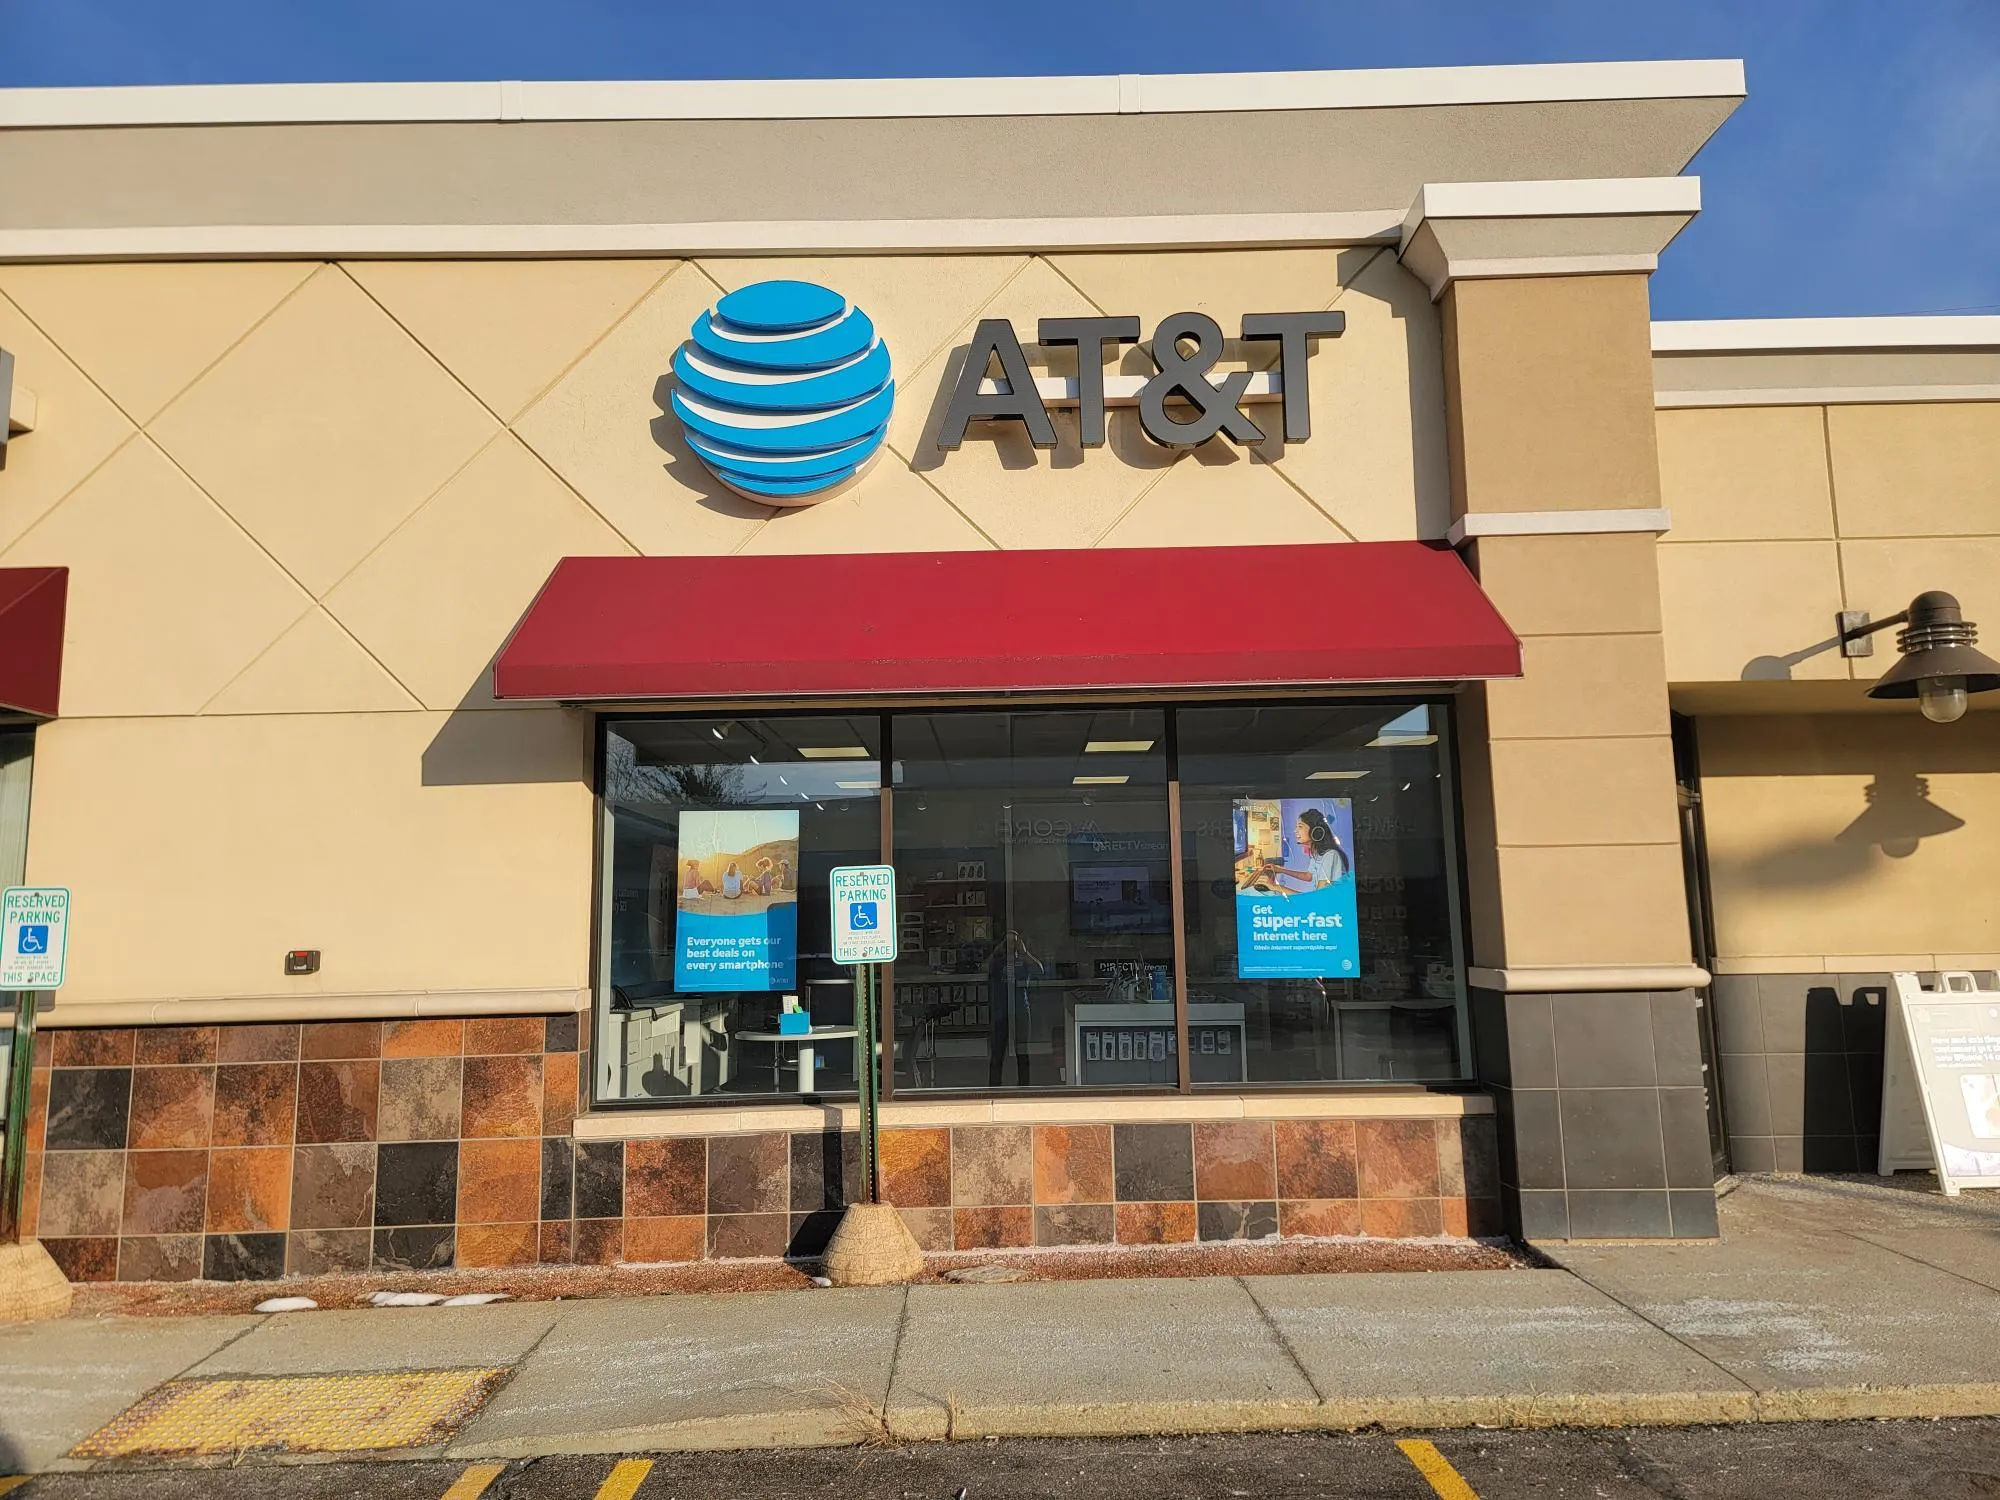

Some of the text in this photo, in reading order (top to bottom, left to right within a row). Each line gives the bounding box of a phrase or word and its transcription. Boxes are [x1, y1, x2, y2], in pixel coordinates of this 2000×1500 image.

[936, 311, 1346, 451] AT&T
[835, 873, 890, 887] RESERVED
[839, 888, 887, 902] PARKING
[6, 895, 66, 909] RESERVED
[1251, 904, 1273, 915] Get
[9, 911, 61, 924] PARKING
[1252, 912, 1343, 931] super-fast
[1253, 930, 1328, 941] Internet here
[687, 936, 782, 948] Everyone gets our
[686, 947, 756, 958] best deals on
[838, 945, 891, 957] THIS SPACE
[686, 959, 784, 971] every smartphone
[2, 971, 59, 983] THIS SPACE
